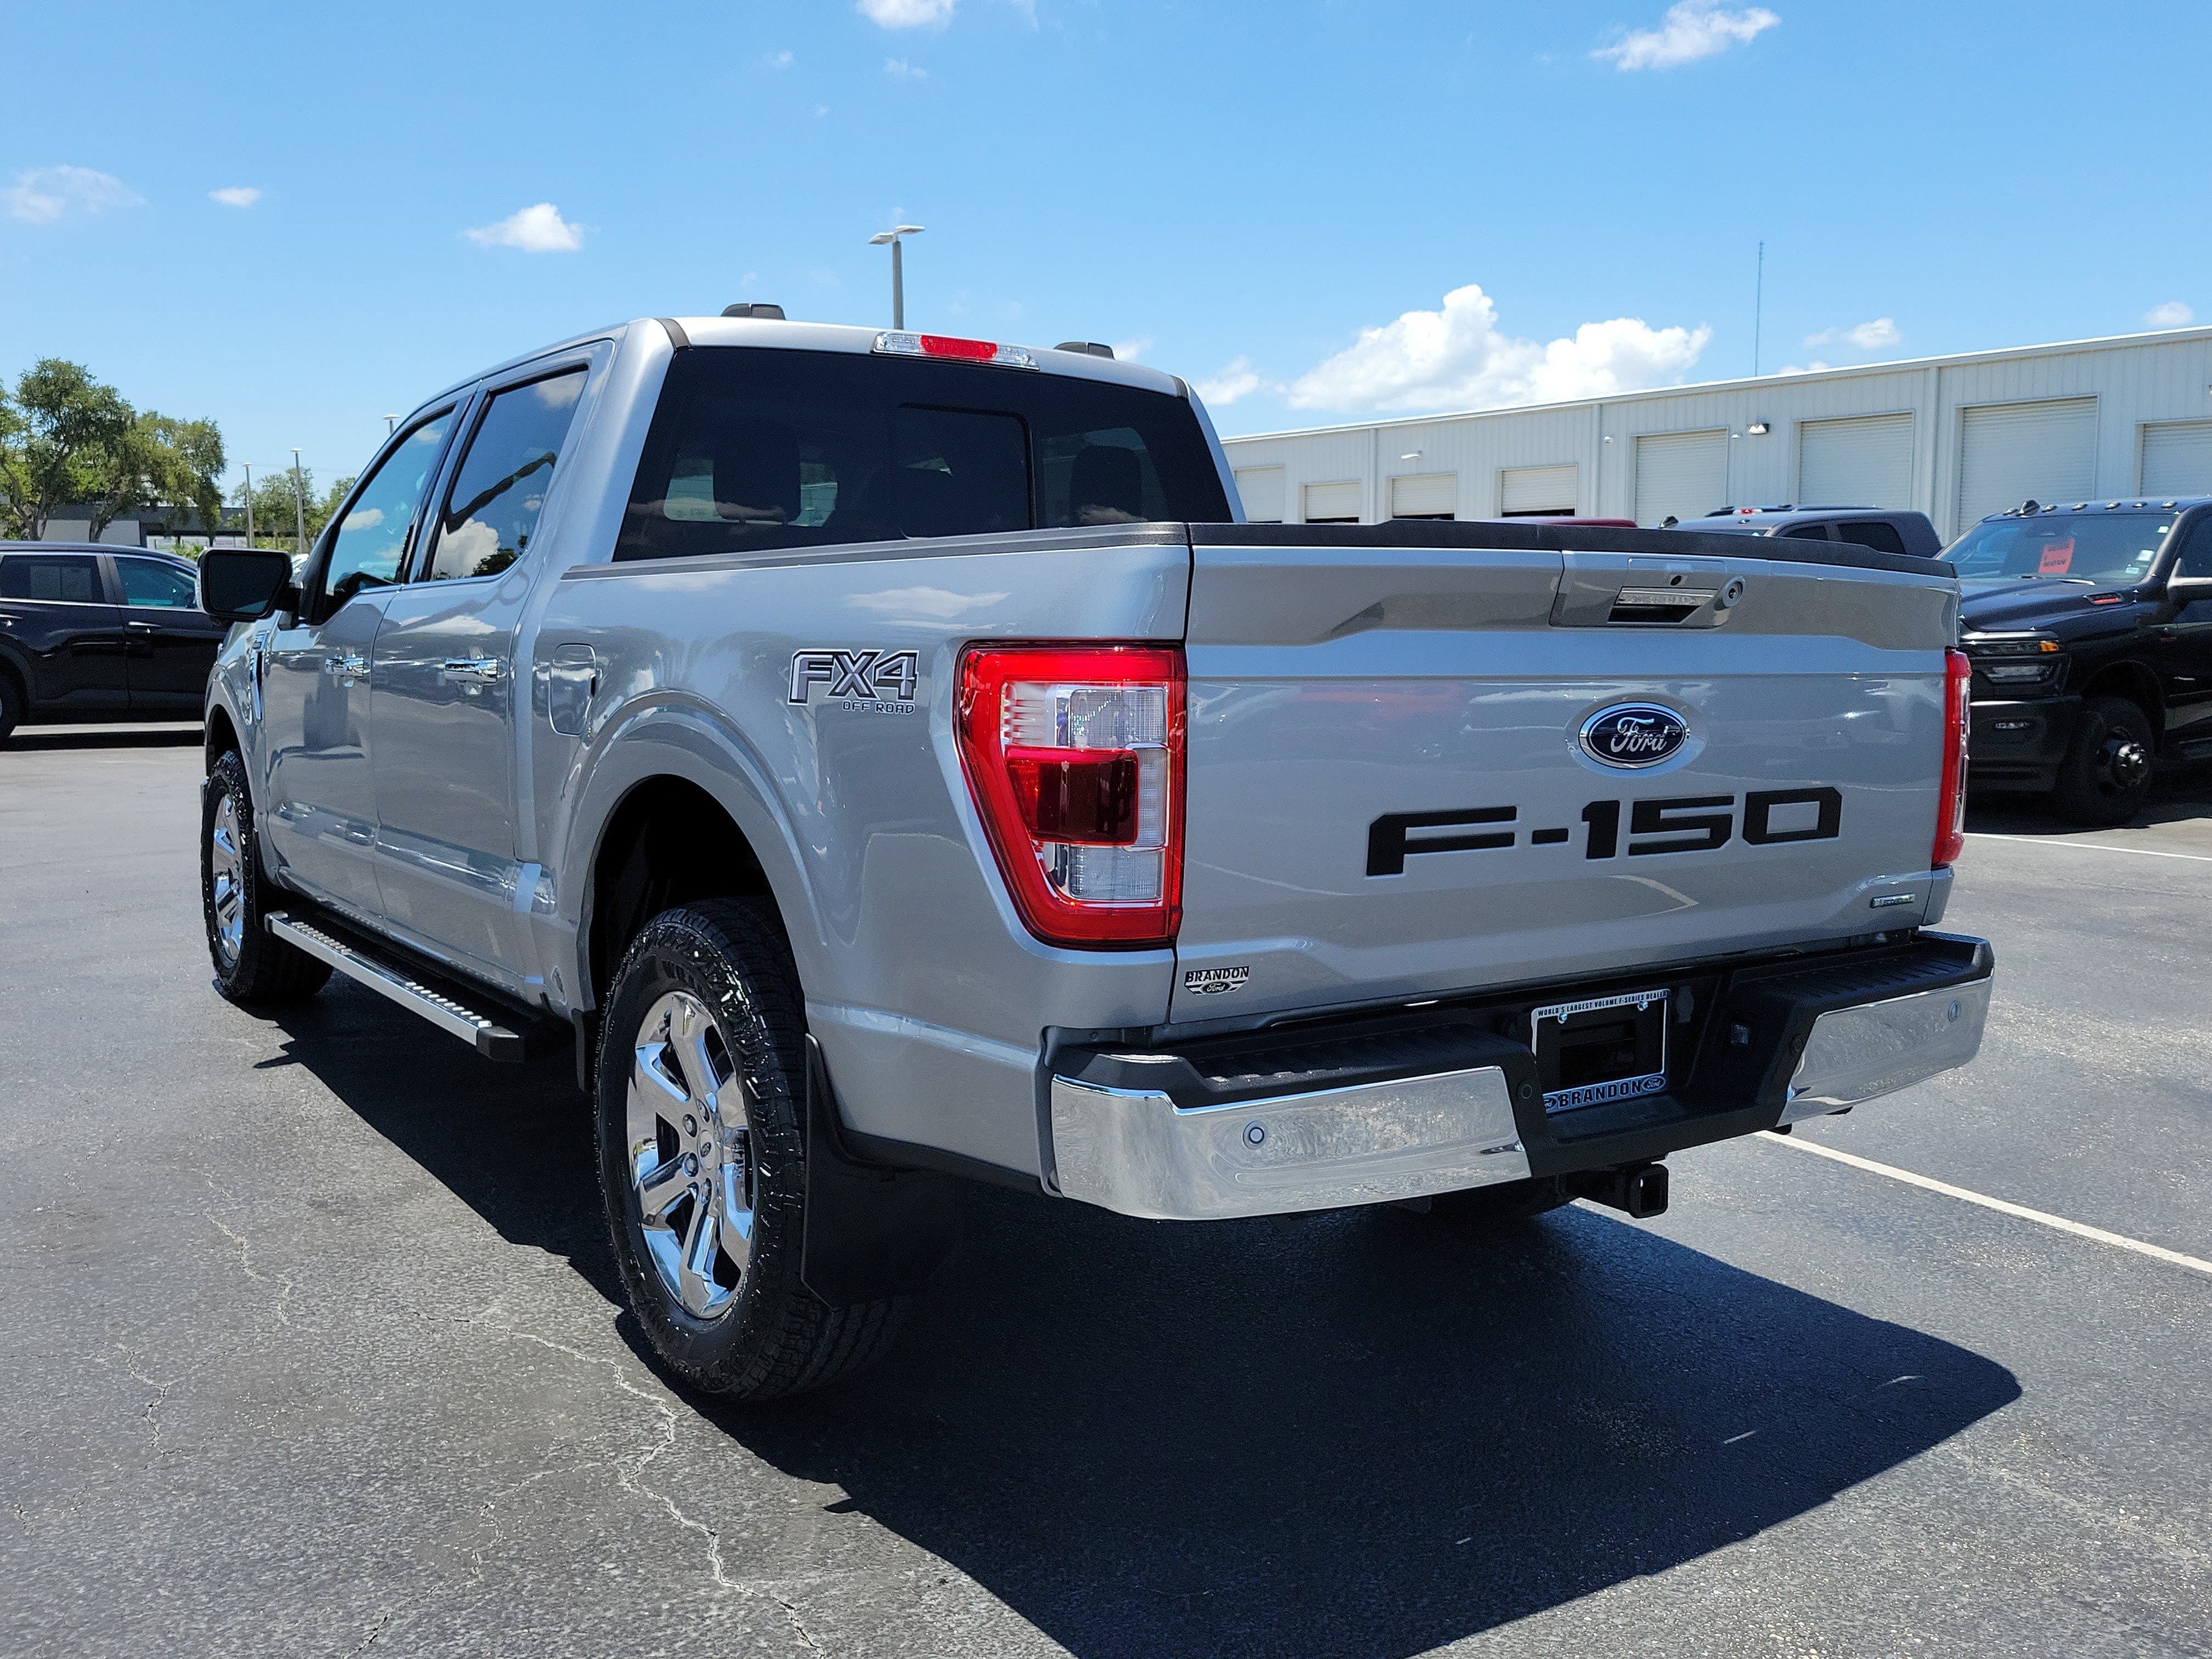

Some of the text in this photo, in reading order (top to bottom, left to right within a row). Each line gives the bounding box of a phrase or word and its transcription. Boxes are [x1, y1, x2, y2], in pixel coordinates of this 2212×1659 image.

[787, 648, 919, 706] FX4
[842, 701, 916, 715] OFF ROAD
[1610, 716, 1668, 753] Ford
[1366, 786, 1842, 877] F-150
[1186, 966, 1250, 983] BRANDON
[1206, 983, 1226, 992] Ford
[1538, 991, 1667, 1017] WORLD'S LARGEST VOLUME F-SERIES DEALER
[1558, 1079, 1642, 1108] BRANDON
